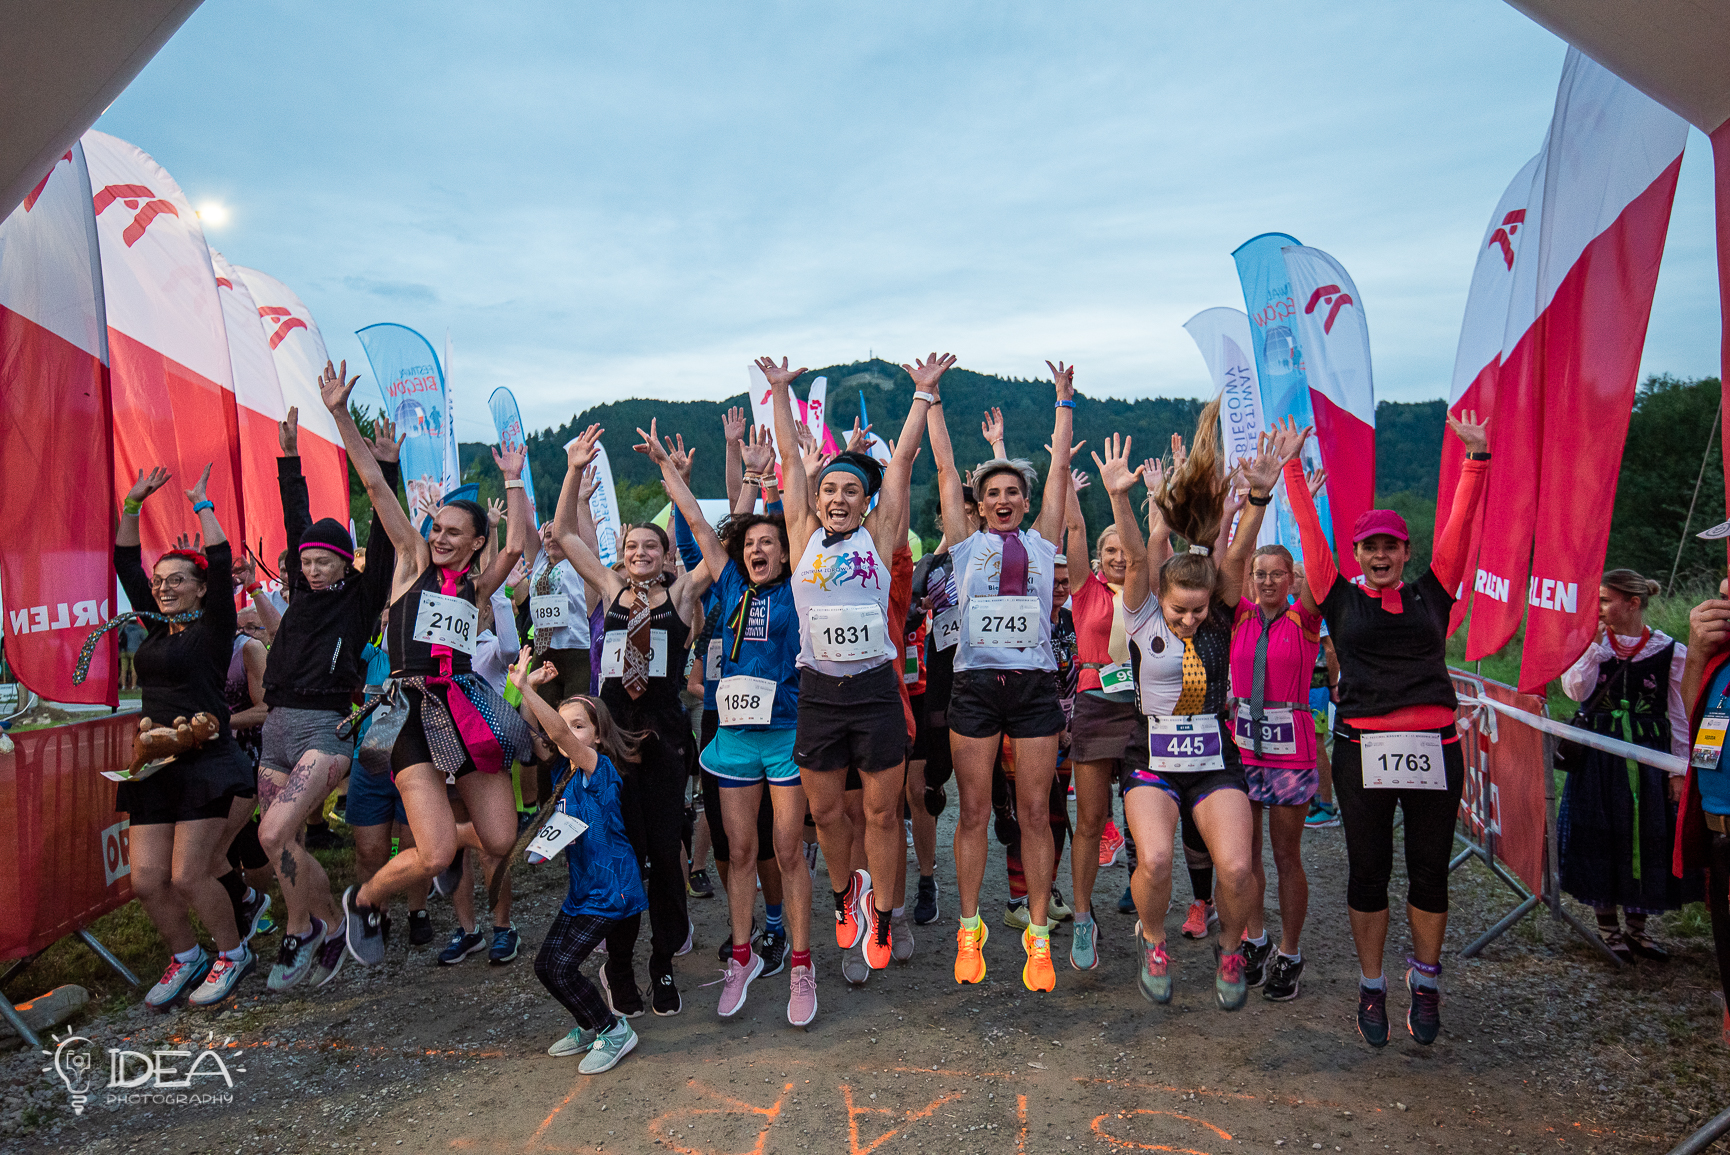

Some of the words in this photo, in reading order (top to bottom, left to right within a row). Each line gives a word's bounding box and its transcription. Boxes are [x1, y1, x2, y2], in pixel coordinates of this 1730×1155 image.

[1474, 568, 1510, 603] RLEN
[1529, 575, 1578, 613] LEN
[535, 607, 560, 619] 1893
[430, 612, 470, 638] 2108
[941, 619, 962, 638] 24
[981, 616, 1028, 633] 2743
[823, 624, 870, 645] 1831
[724, 694, 761, 711] 1858
[1244, 722, 1282, 741] 191
[1167, 736, 1205, 756] 445
[1377, 753, 1432, 772] 1763
[537, 824, 562, 842] 60
